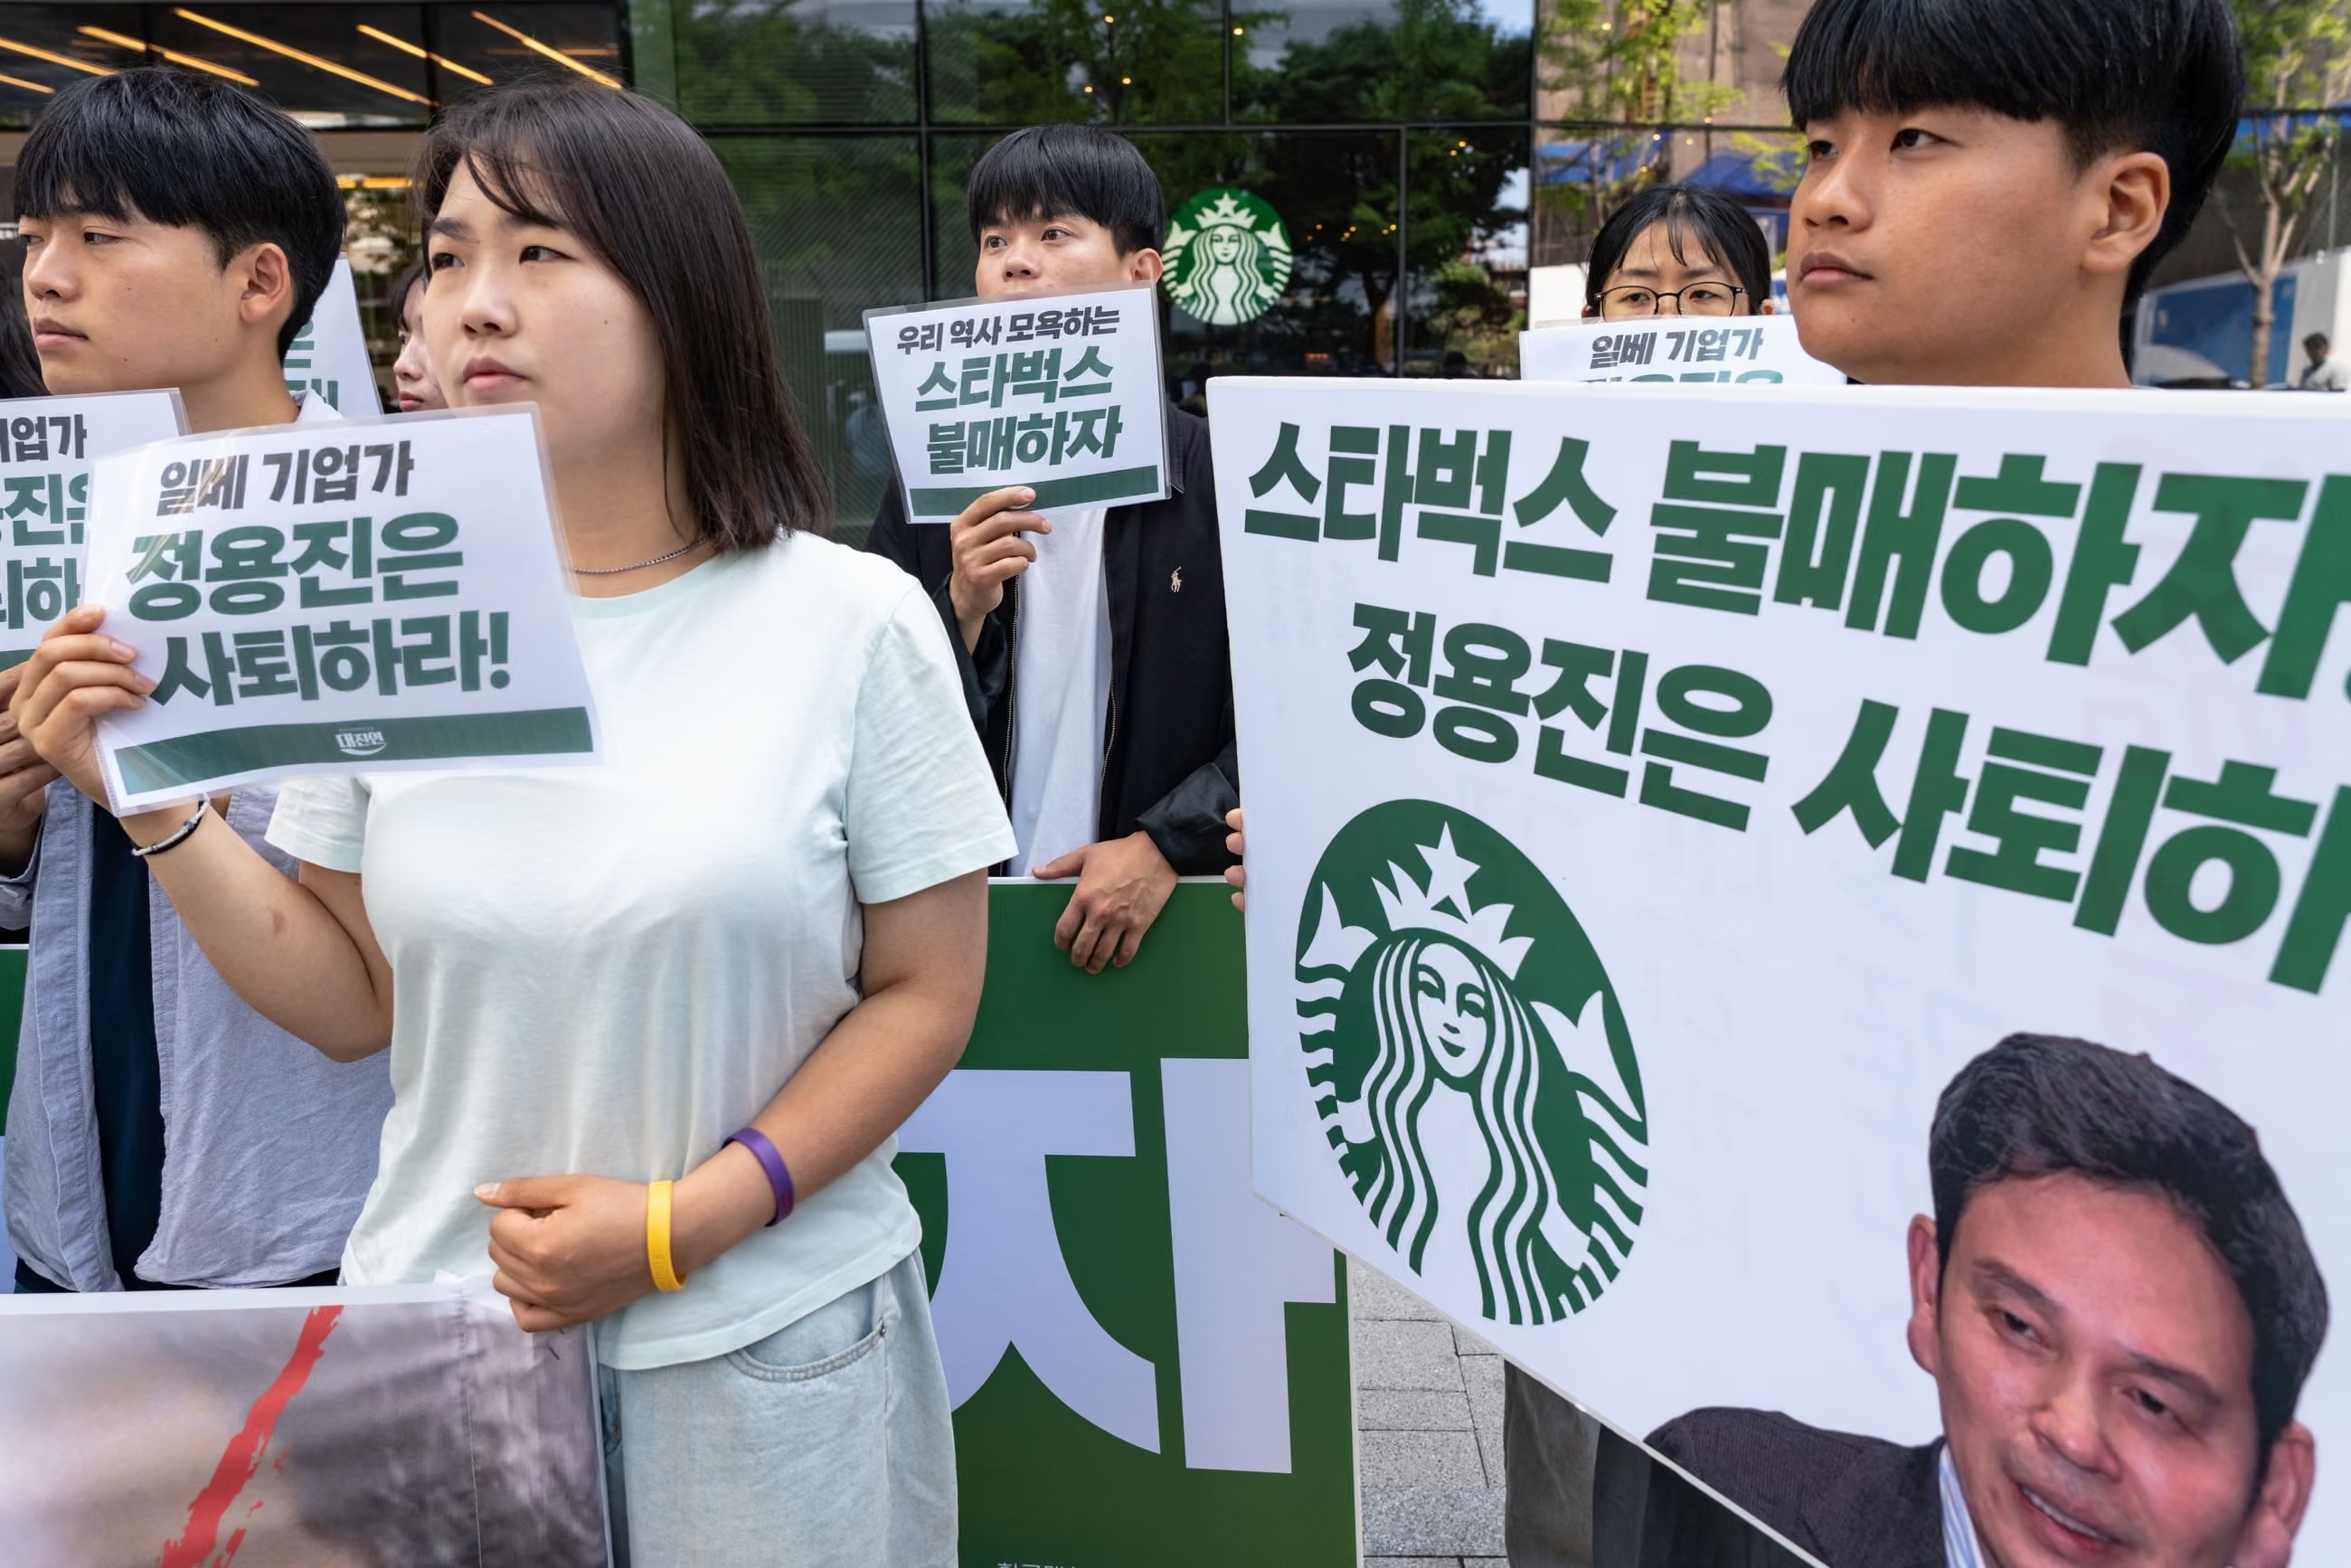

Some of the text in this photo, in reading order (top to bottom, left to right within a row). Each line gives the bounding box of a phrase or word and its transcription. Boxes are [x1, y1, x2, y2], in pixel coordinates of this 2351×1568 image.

[897, 306, 1120, 354] 우리 역사 모욕하는
[1590, 327, 1763, 370] 일베 기업가
[915, 345, 1114, 412] 스타벅스
[156, 454, 250, 516] 일베
[262, 439, 415, 505] 기업가
[927, 405, 1123, 474] 불매하자
[1244, 421, 1619, 584] 스타벅스
[126, 511, 463, 621] 정용진은
[149, 610, 510, 707] 사퇴하라!
[1346, 602, 1773, 835] 정용진은
